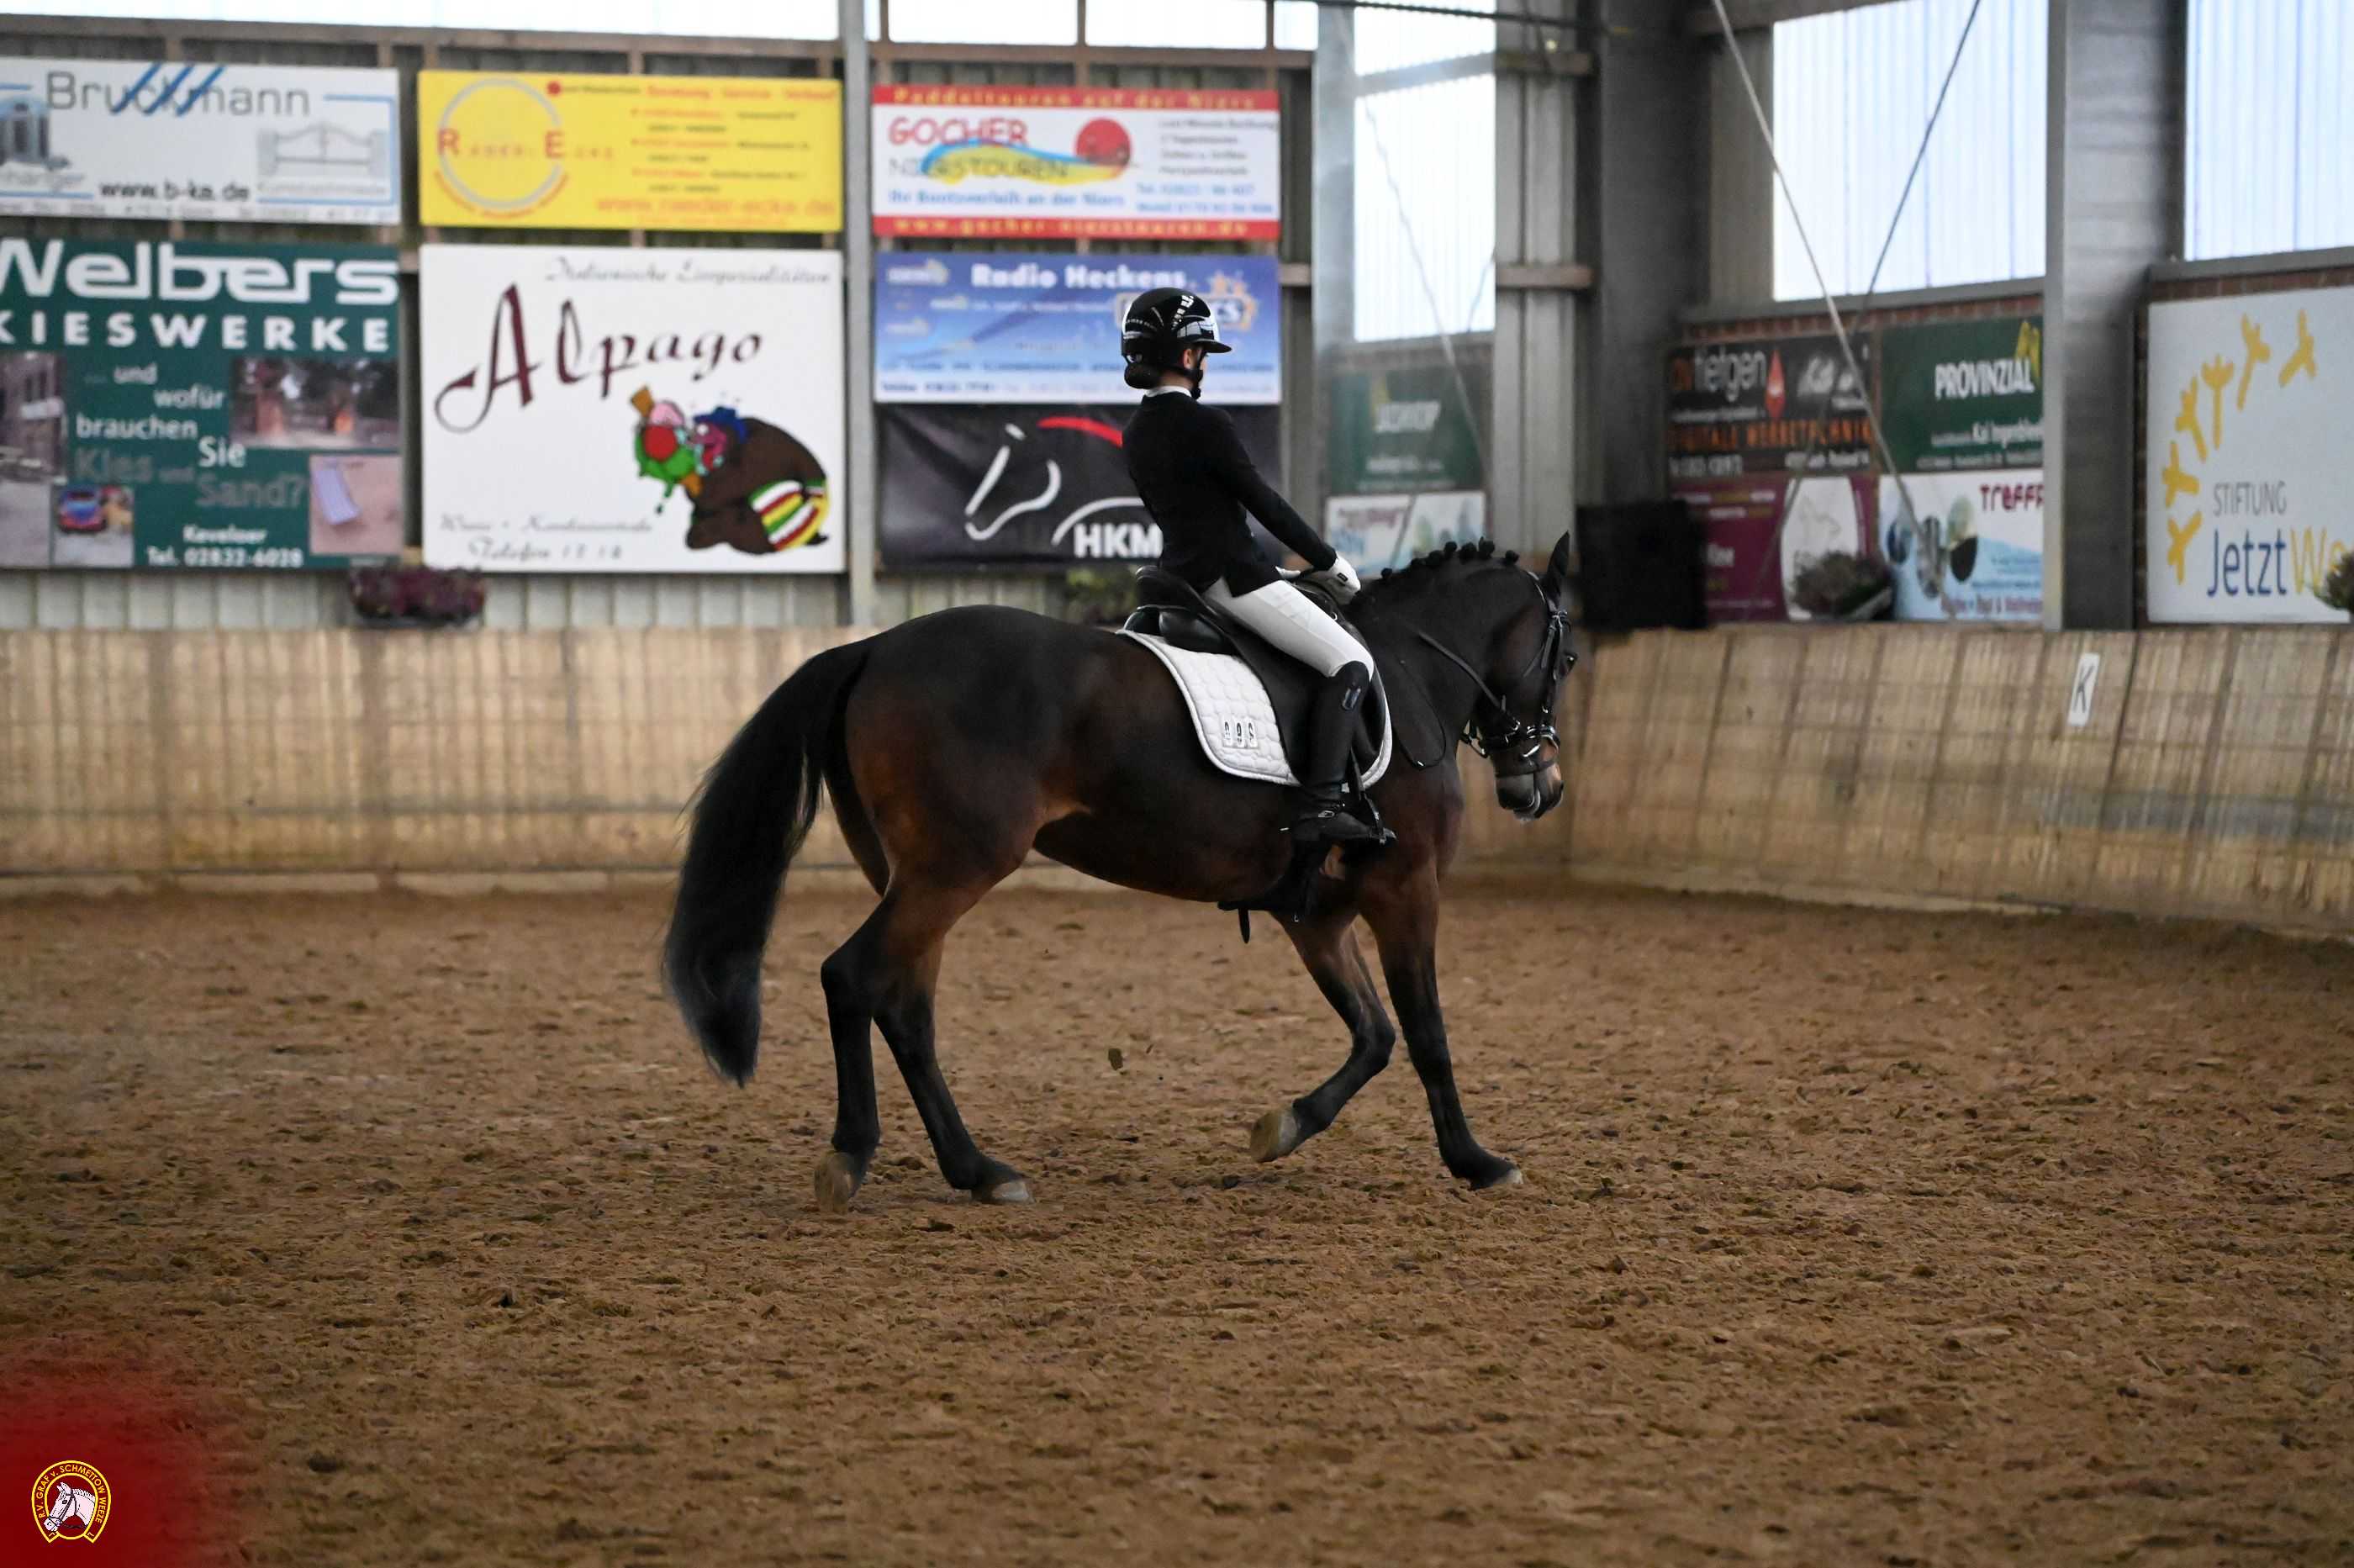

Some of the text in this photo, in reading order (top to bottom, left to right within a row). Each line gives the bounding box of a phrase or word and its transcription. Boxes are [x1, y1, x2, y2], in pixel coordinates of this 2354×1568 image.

[888, 117, 1028, 148] GOCHER
[0, 238, 400, 305] Welbers
[970, 262, 1058, 289] Radio
[1064, 263, 1186, 291] Heckens
[433, 282, 763, 435] Alpago
[153, 383, 224, 410] wofür
[1934, 356, 2035, 401] PROVINZIAL
[76, 415, 198, 439] brauchen
[198, 437, 247, 468] Sie
[195, 473, 307, 508] Sand?
[2213, 480, 2287, 517] STIFTUNG
[1074, 522, 1164, 559] HKM
[2074, 664, 2095, 715] K
